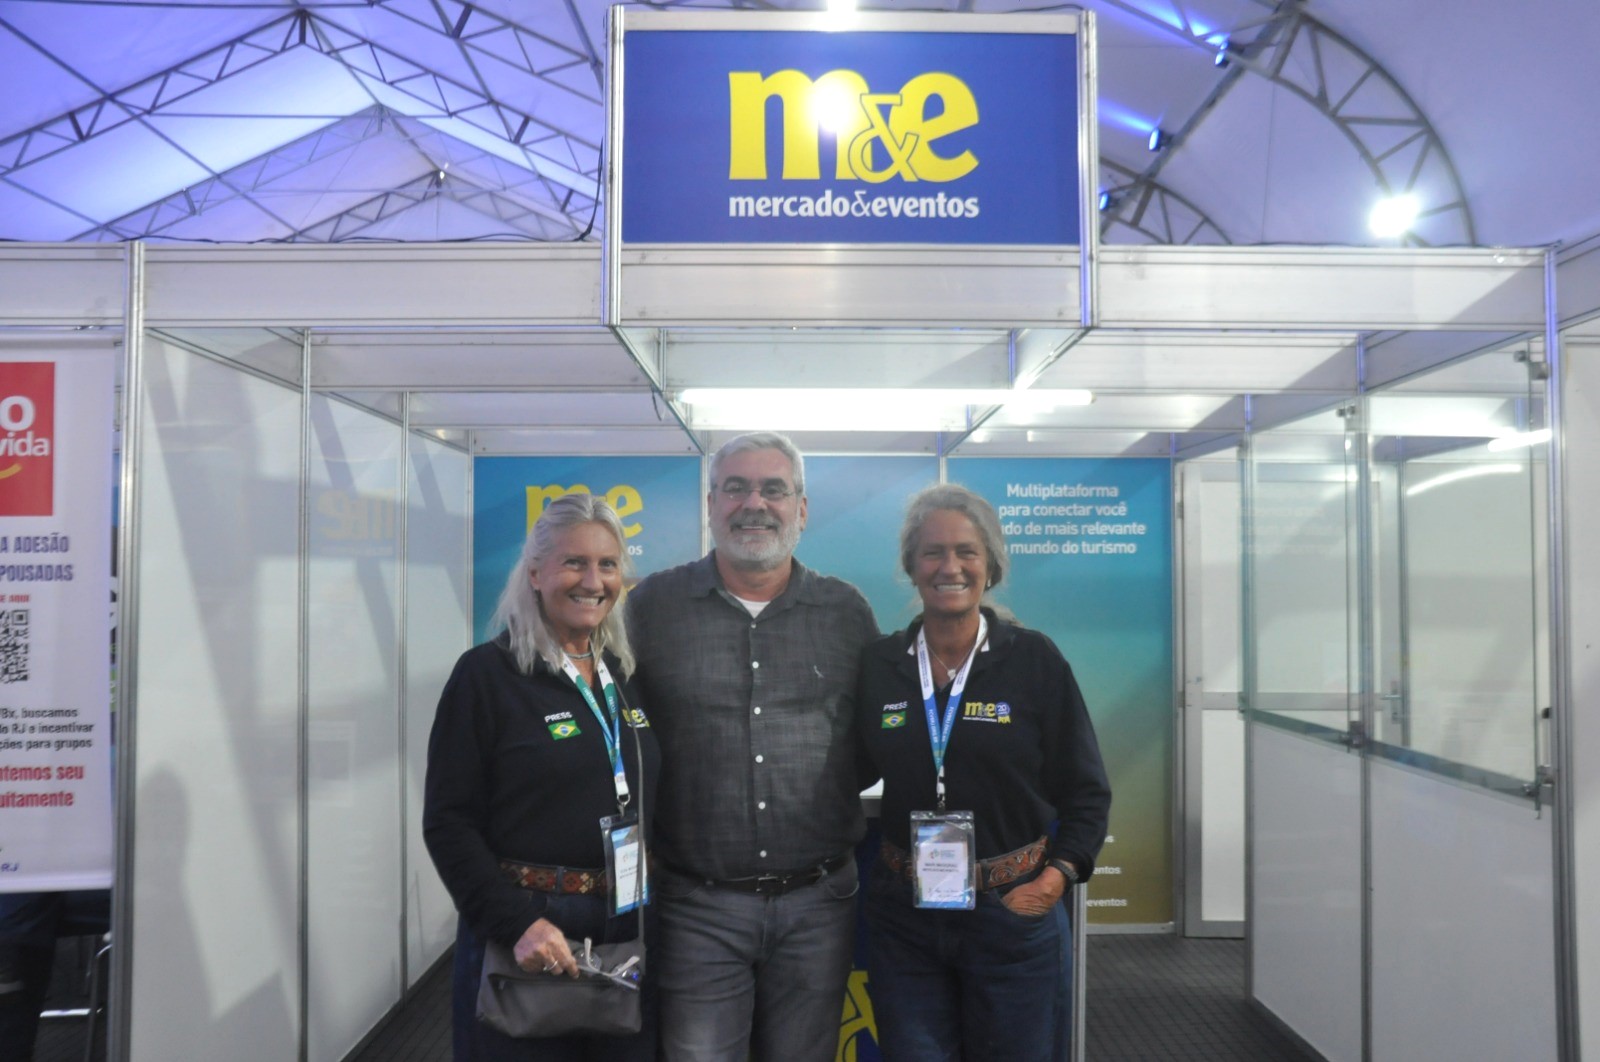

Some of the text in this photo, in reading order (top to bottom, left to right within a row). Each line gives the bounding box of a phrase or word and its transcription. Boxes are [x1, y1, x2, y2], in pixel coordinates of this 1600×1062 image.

[729, 69, 980, 183] m&e
[729, 190, 980, 218] mercado&eventos
[1006, 483, 1119, 500] Multiplataforma
[998, 501, 1128, 519] para conectar você
[1024, 521, 1042, 535] de
[1044, 521, 1078, 535] mais
[1081, 521, 1146, 535] relevante
[14, 531, 70, 554] ADESÃO
[1010, 540, 1059, 554] mundo
[1061, 540, 1079, 554] do
[1081, 540, 1137, 554] turismo
[21, 707, 79, 719] buscamos
[881, 701, 908, 711] PRESS
[28, 725, 36, 734] e
[38, 721, 95, 734] incentivar
[25, 740, 52, 752] para
[54, 739, 93, 752] grupos
[56, 765, 84, 780] seu
